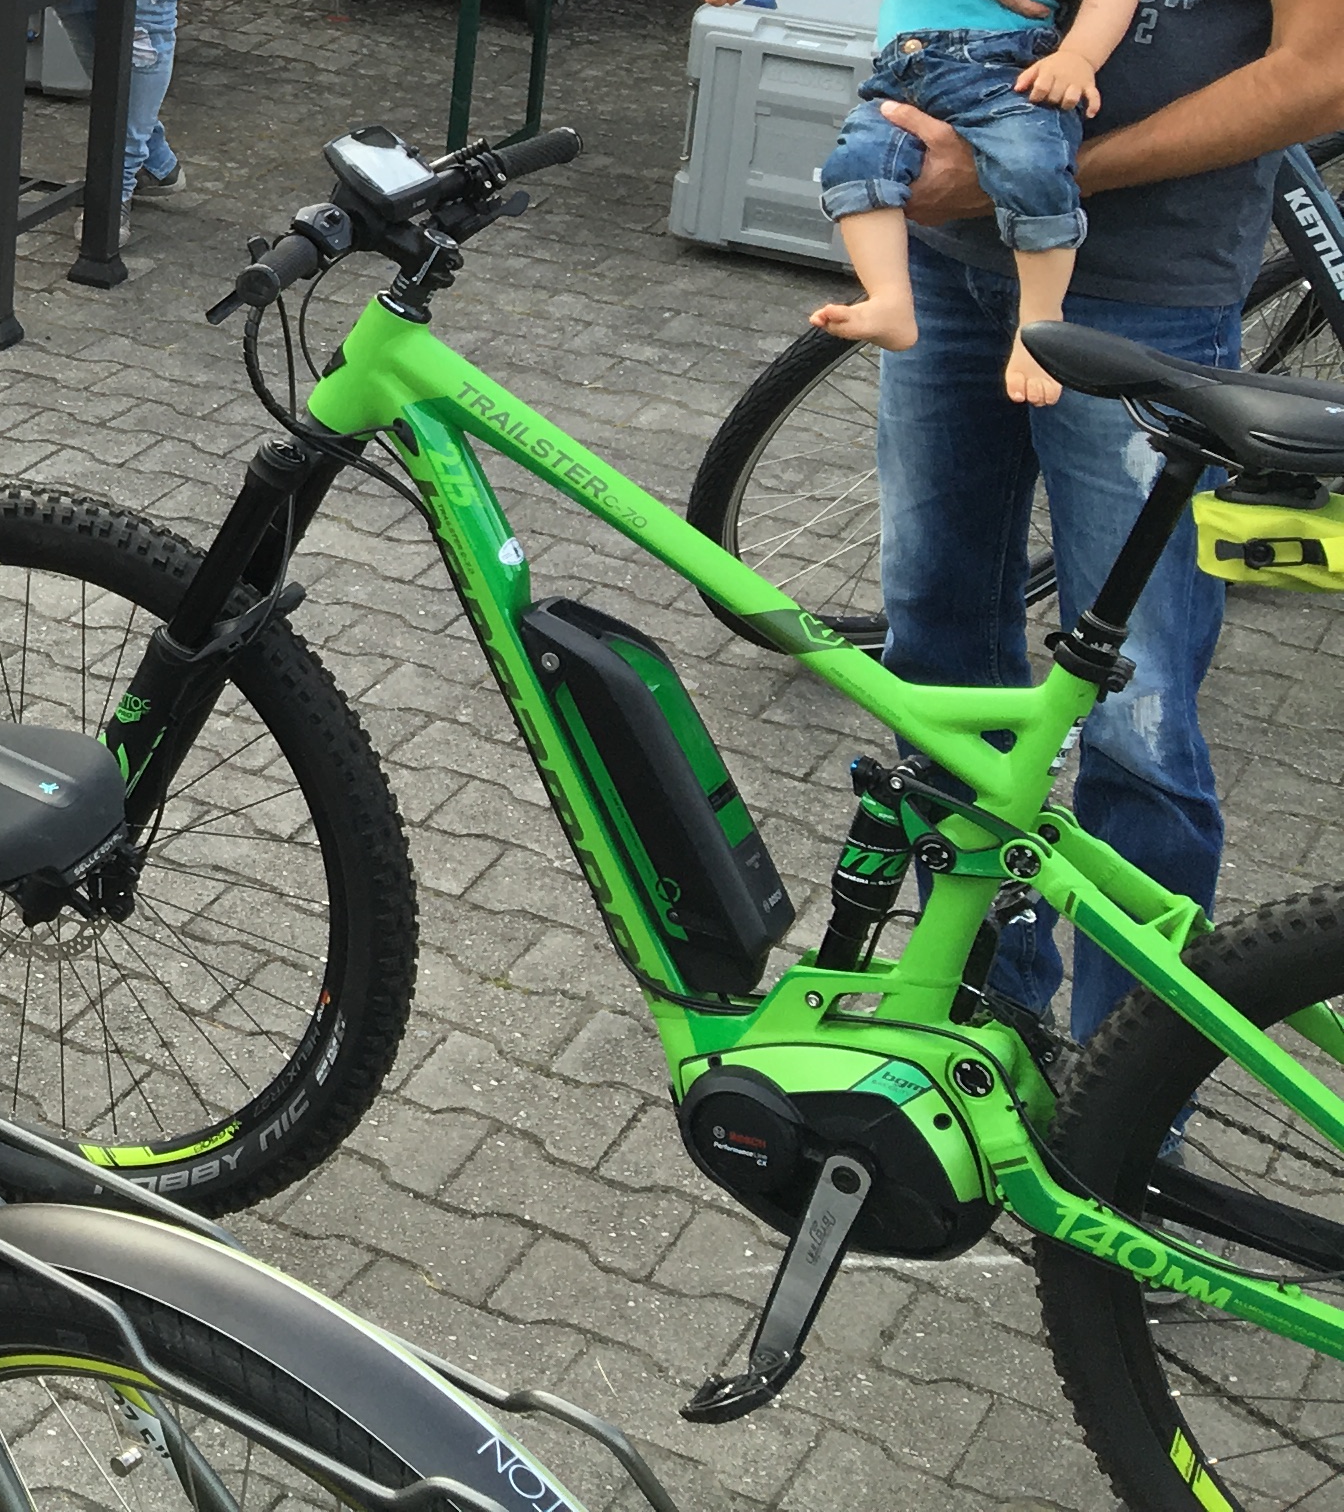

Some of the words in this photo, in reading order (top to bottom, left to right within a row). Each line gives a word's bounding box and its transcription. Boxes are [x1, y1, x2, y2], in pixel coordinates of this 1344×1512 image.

[1282, 187, 1344, 302] KETTLE
[456, 380, 611, 507] TRAILSTER
[258, 1087, 310, 1152] NIC
[728, 1131, 768, 1149] BOSCH
